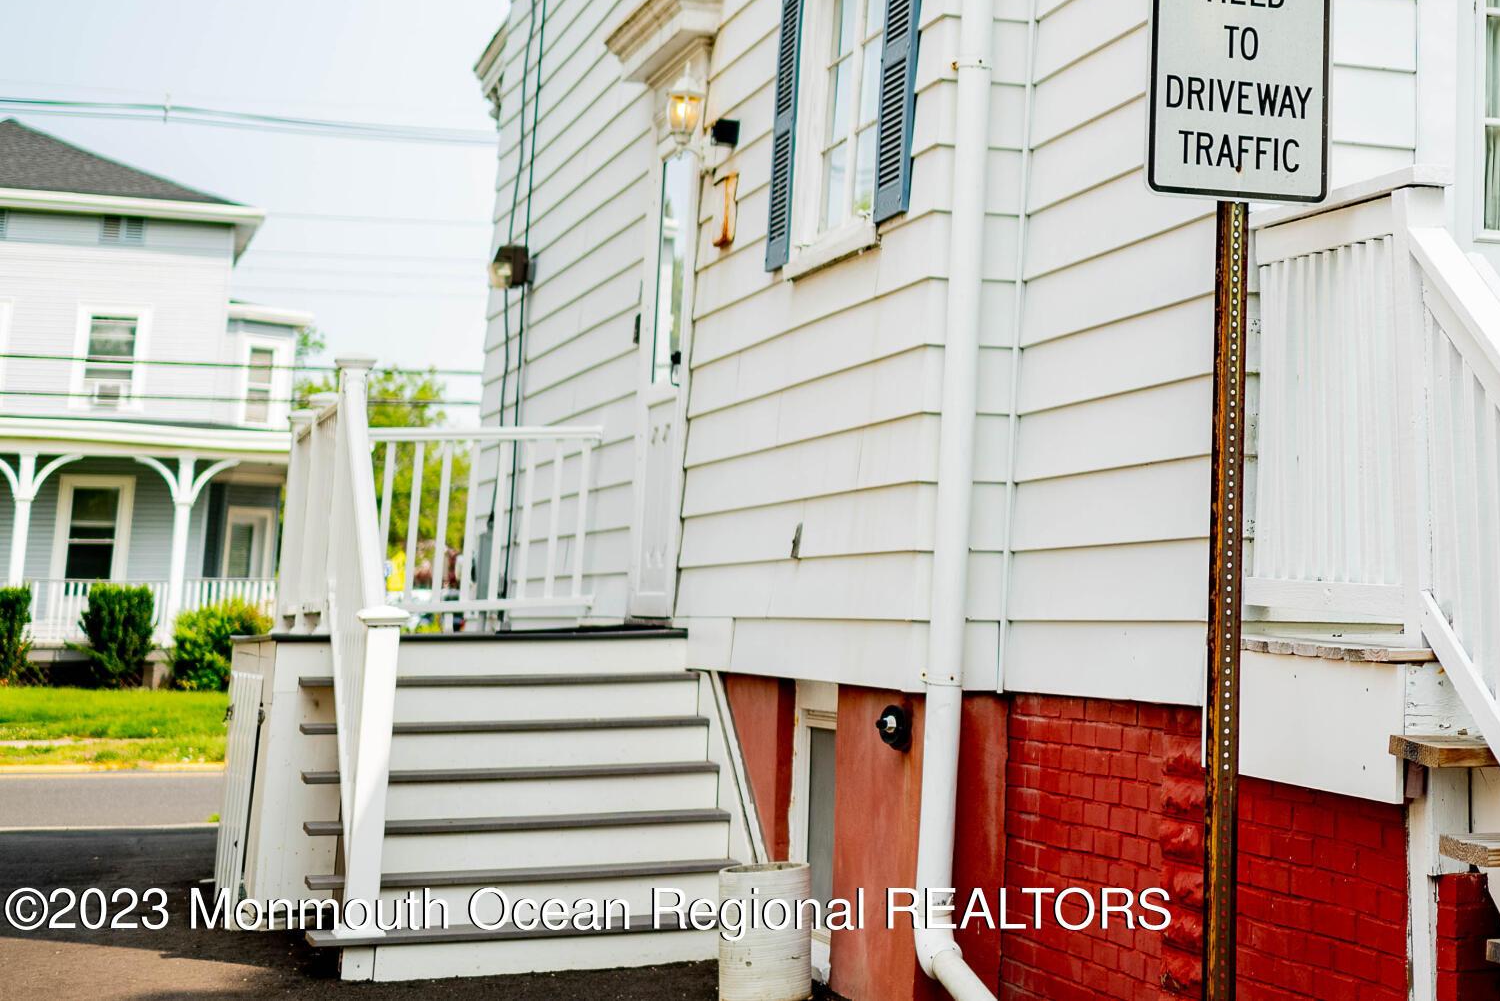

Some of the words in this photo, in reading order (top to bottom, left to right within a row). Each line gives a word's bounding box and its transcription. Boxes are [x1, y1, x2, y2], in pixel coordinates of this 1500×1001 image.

[1224, 25, 1259, 61] TO
[1166, 74, 1313, 119] DRIVEWAY
[1178, 130, 1300, 173] TRAFFIC
